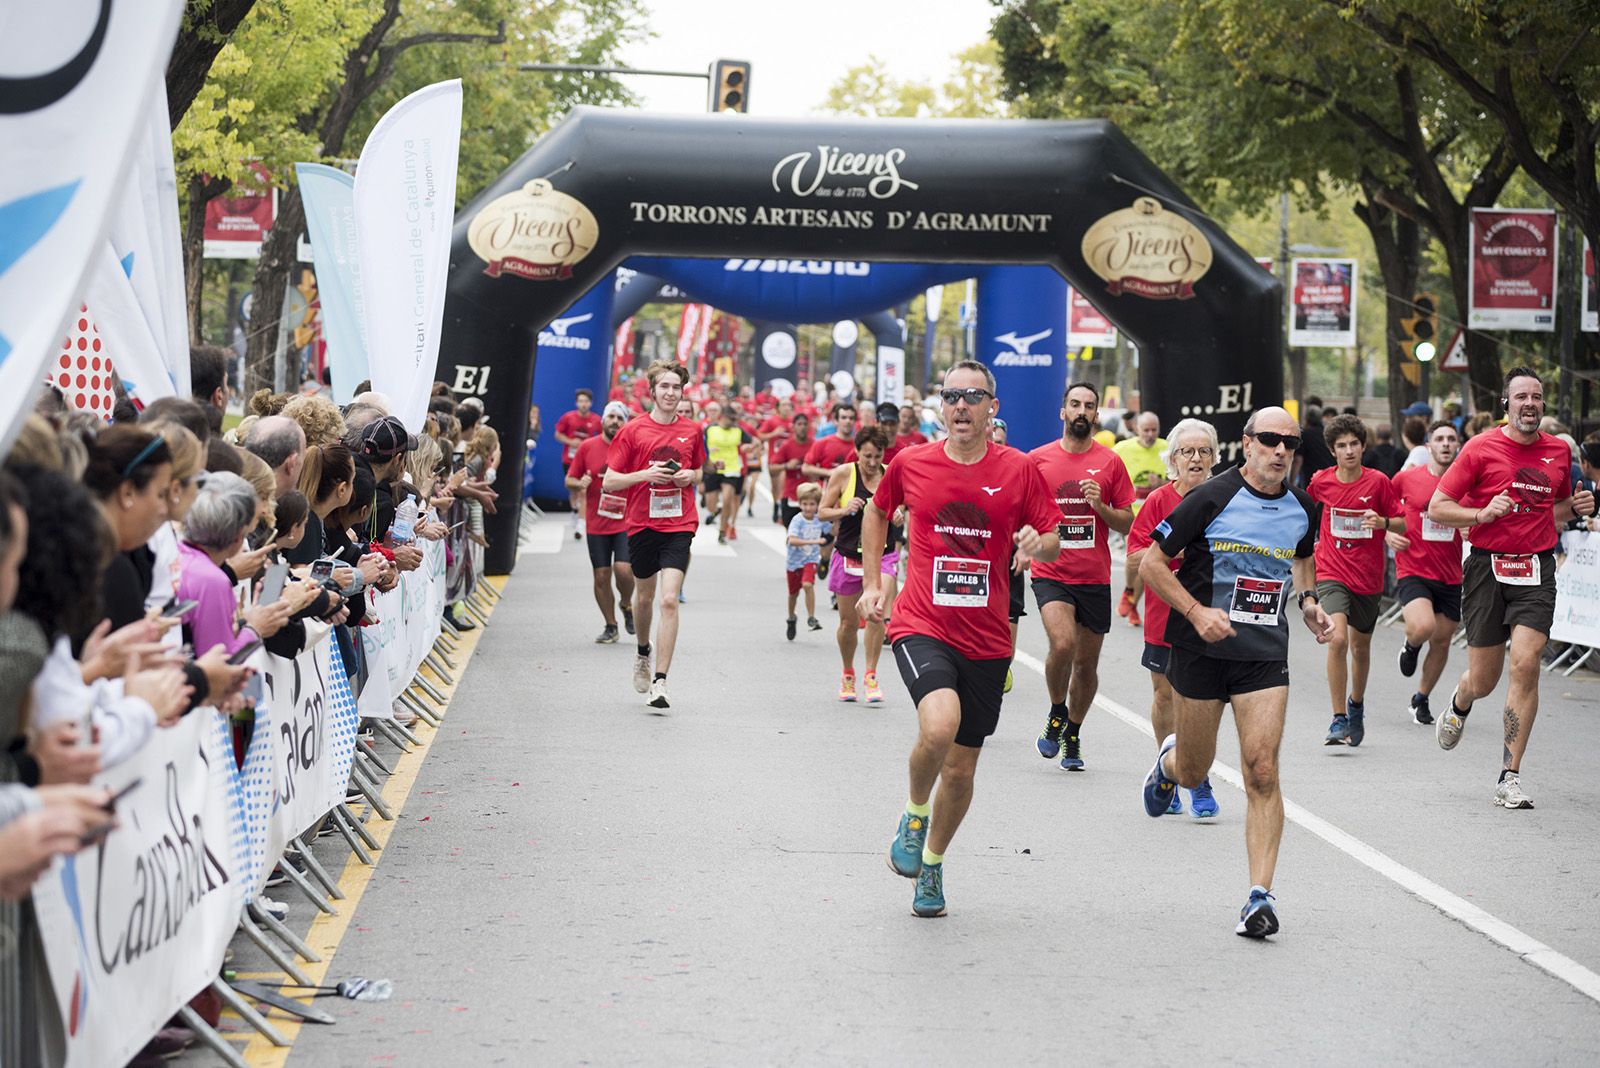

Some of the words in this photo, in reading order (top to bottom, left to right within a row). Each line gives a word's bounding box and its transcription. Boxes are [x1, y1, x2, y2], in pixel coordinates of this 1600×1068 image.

[404, 139, 420, 223] Catalunya
[772, 145, 919, 198] Vicens
[630, 202, 748, 225] TORRONS
[752, 206, 874, 229] ARTESANS
[887, 211, 1052, 232] D'AGRAMUNT
[408, 228, 423, 250] de
[477, 212, 589, 258] Vicens
[1091, 232, 1206, 276] Vicens
[503, 261, 557, 275] AGRAMUNT
[451, 364, 491, 395] El
[934, 524, 954, 534] SANT
[954, 527, 980, 537] CUGAT
[1067, 526, 1085, 534] LUIS
[1213, 541, 1271, 557] RUNNING
[947, 574, 978, 585] CARLES
[1246, 592, 1272, 604] JOAN
